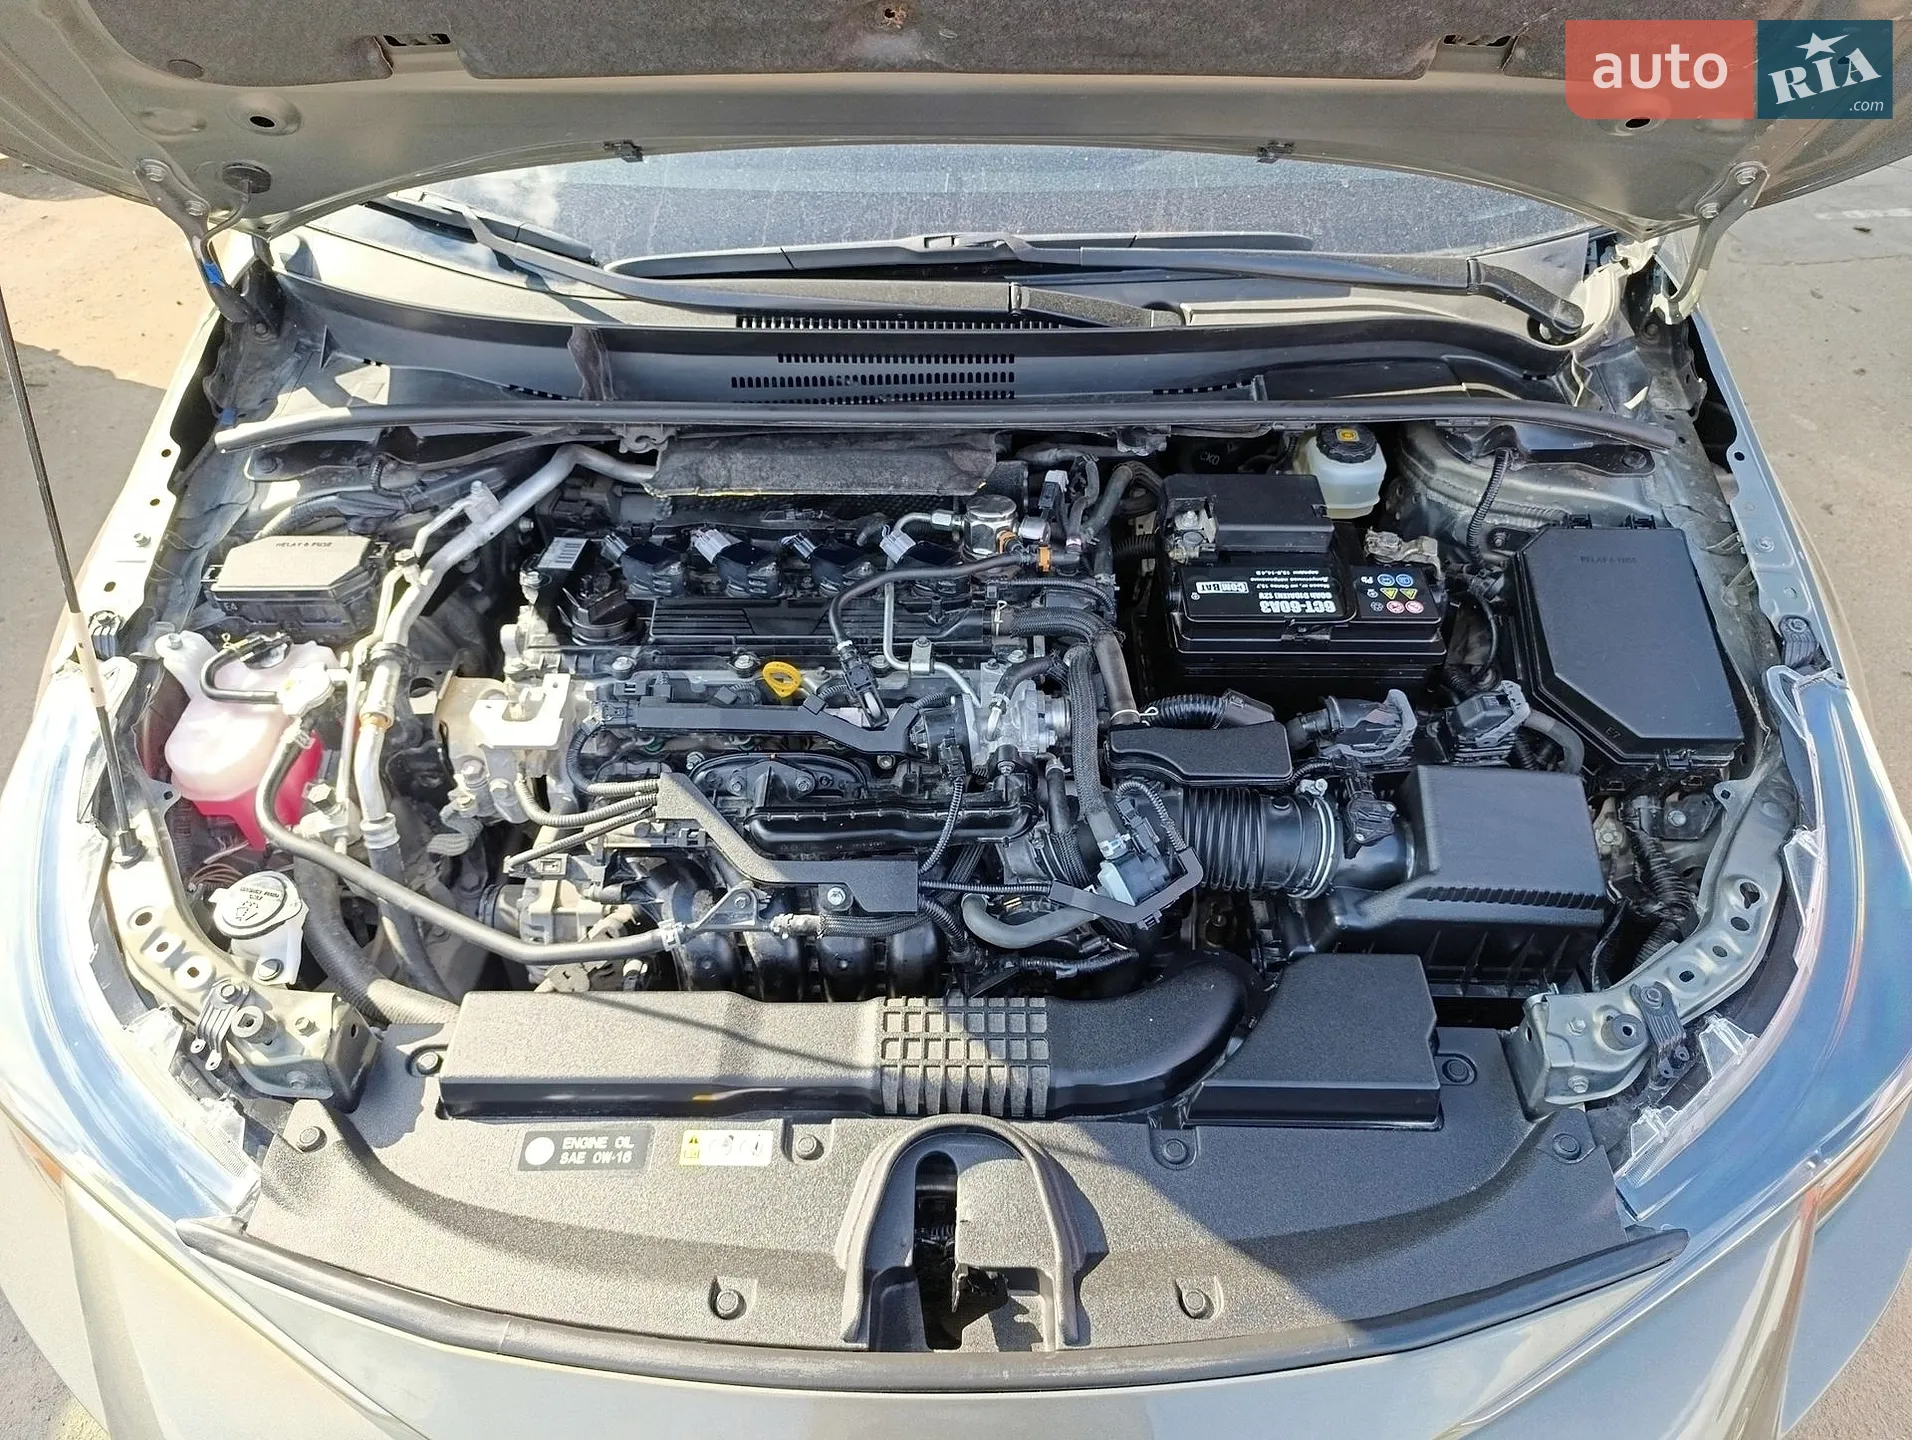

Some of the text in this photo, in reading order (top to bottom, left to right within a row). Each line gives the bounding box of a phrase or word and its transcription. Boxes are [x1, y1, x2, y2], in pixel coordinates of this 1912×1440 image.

[1361, 576, 1374, 584] Pb
[562, 1135, 635, 1149] ENGINE OIL
[560, 1150, 633, 1164] SAE 0W-16
